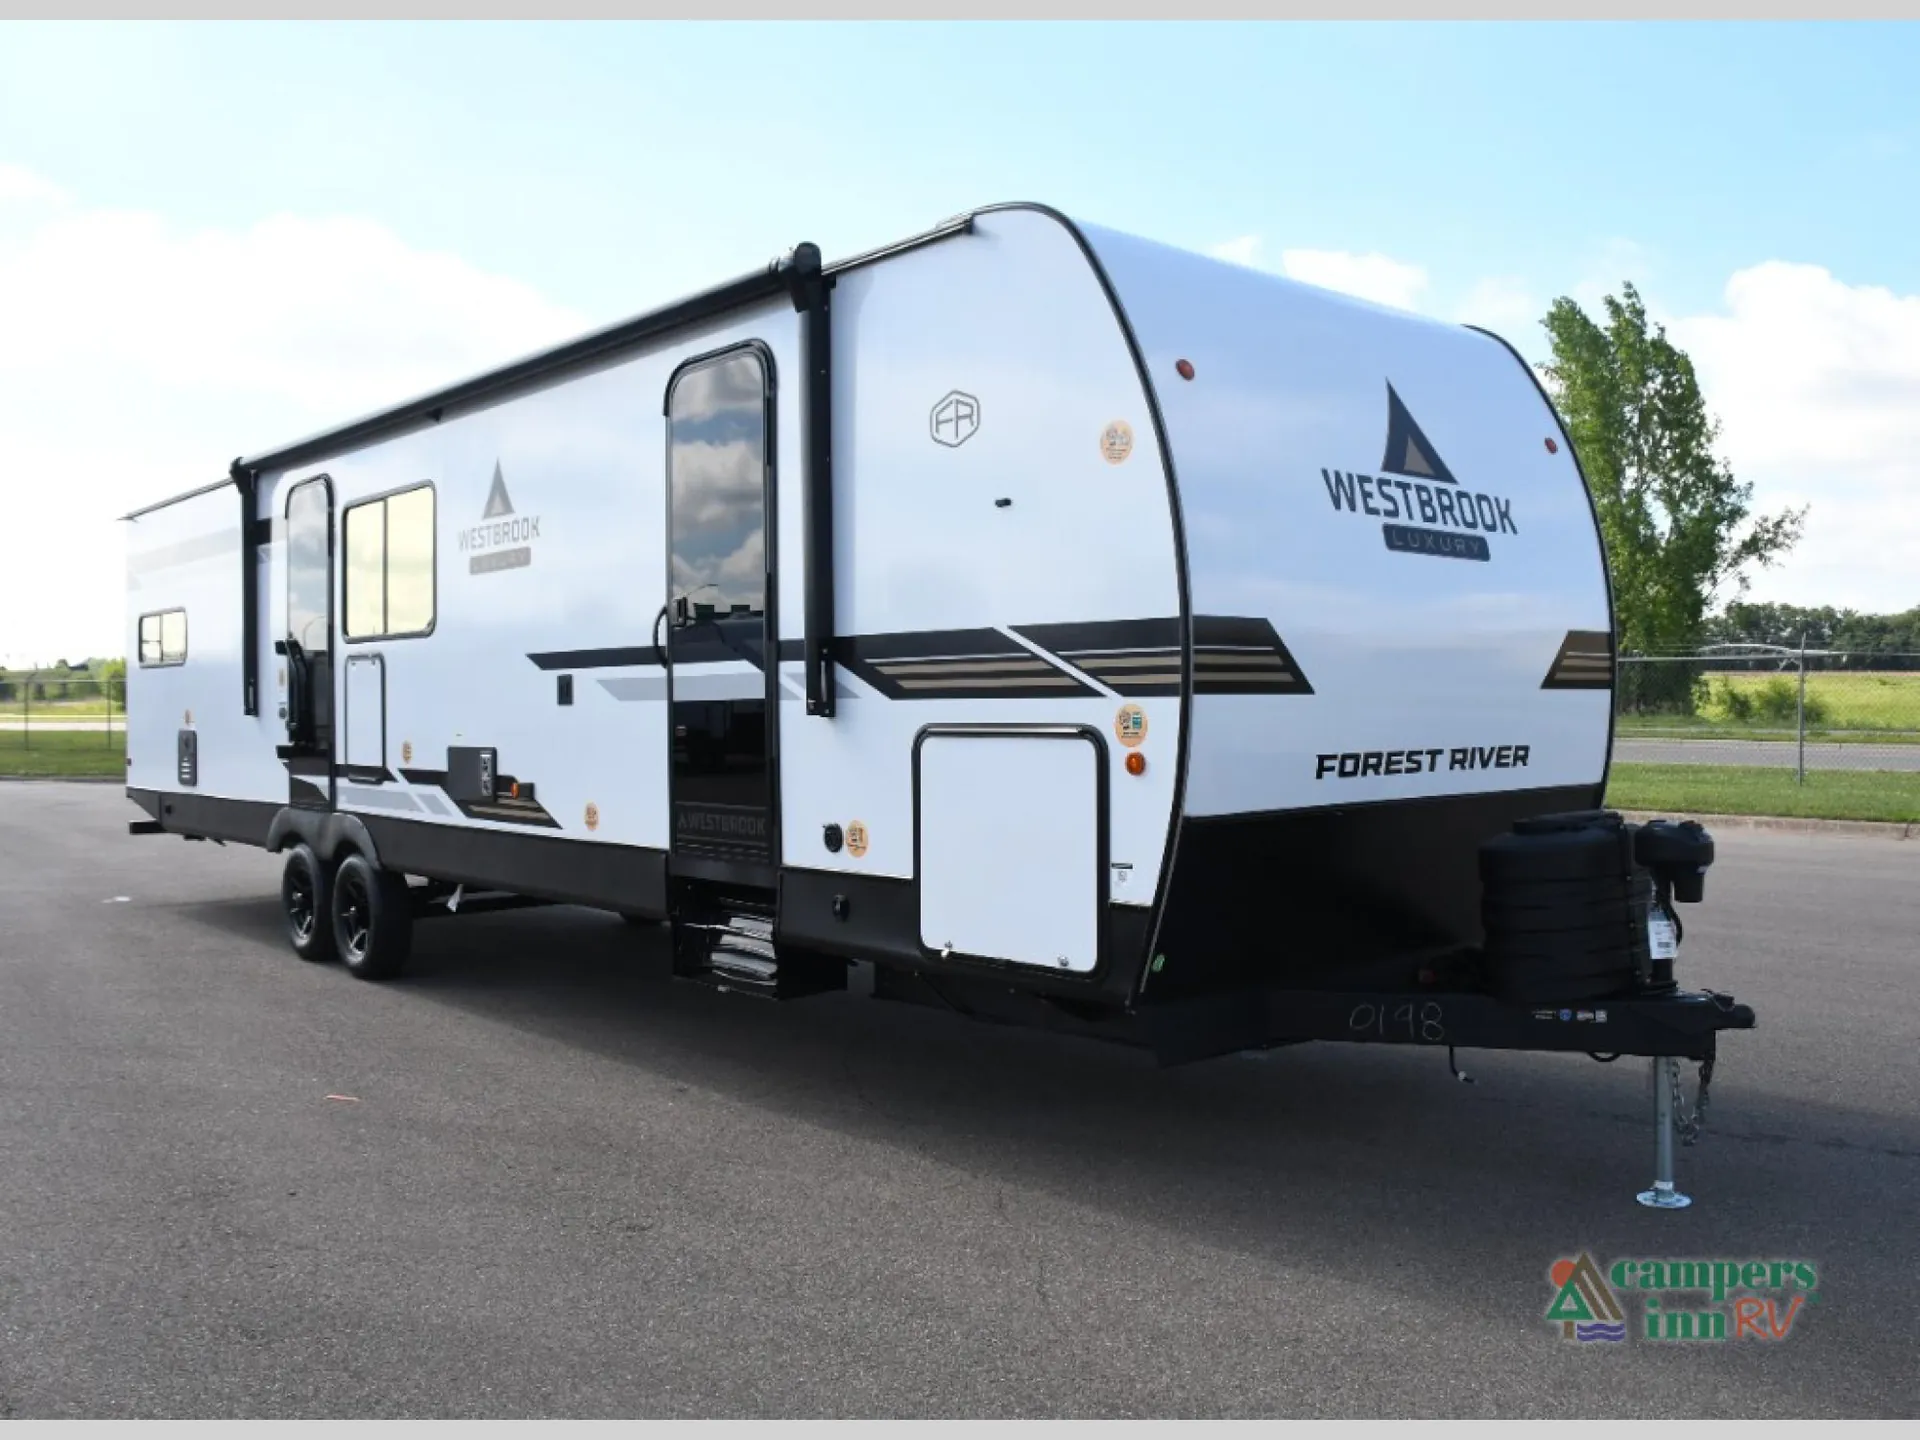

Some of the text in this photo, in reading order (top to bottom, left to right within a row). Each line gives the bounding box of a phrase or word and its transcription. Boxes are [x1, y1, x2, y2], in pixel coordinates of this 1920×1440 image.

[1320, 466, 1519, 536] WESTBROOK
[457, 515, 541, 553] WESTBROOK
[1391, 528, 1480, 555] LUXURY
[1315, 744, 1531, 780] FOREST RIVER
